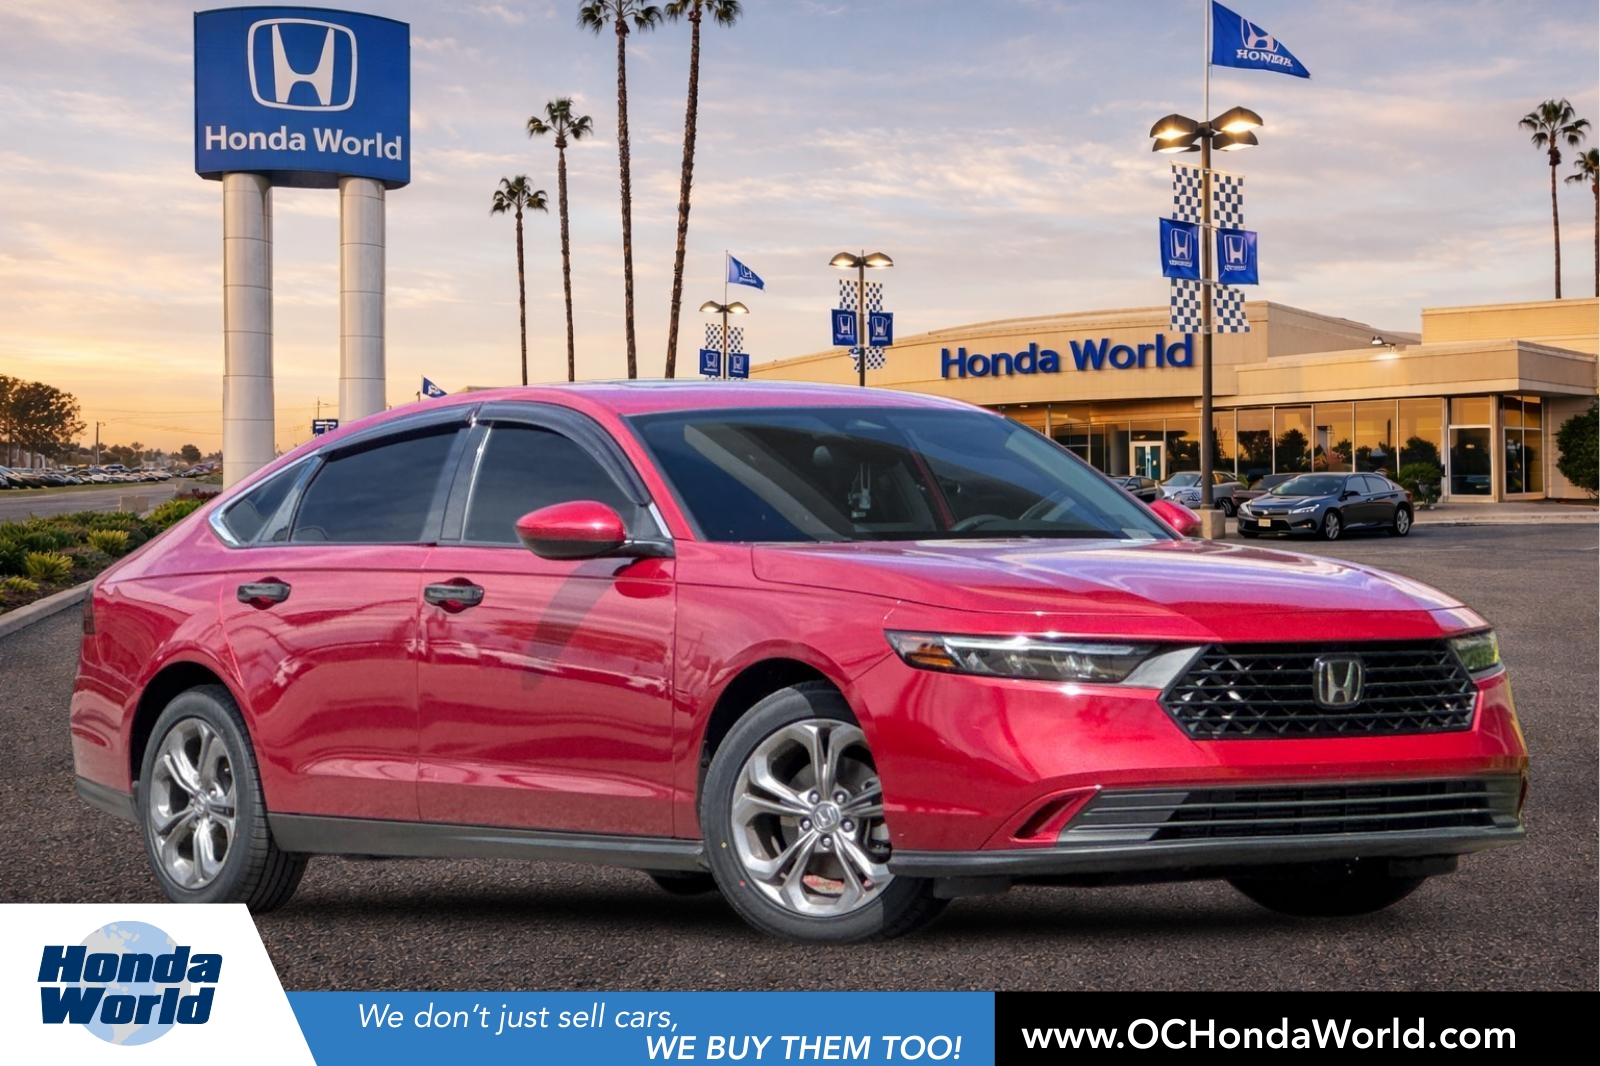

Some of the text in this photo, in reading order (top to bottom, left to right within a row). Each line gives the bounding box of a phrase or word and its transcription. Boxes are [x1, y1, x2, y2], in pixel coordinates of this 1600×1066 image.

[205, 125, 402, 161] Honda World
[941, 333, 1194, 379] Honda World
